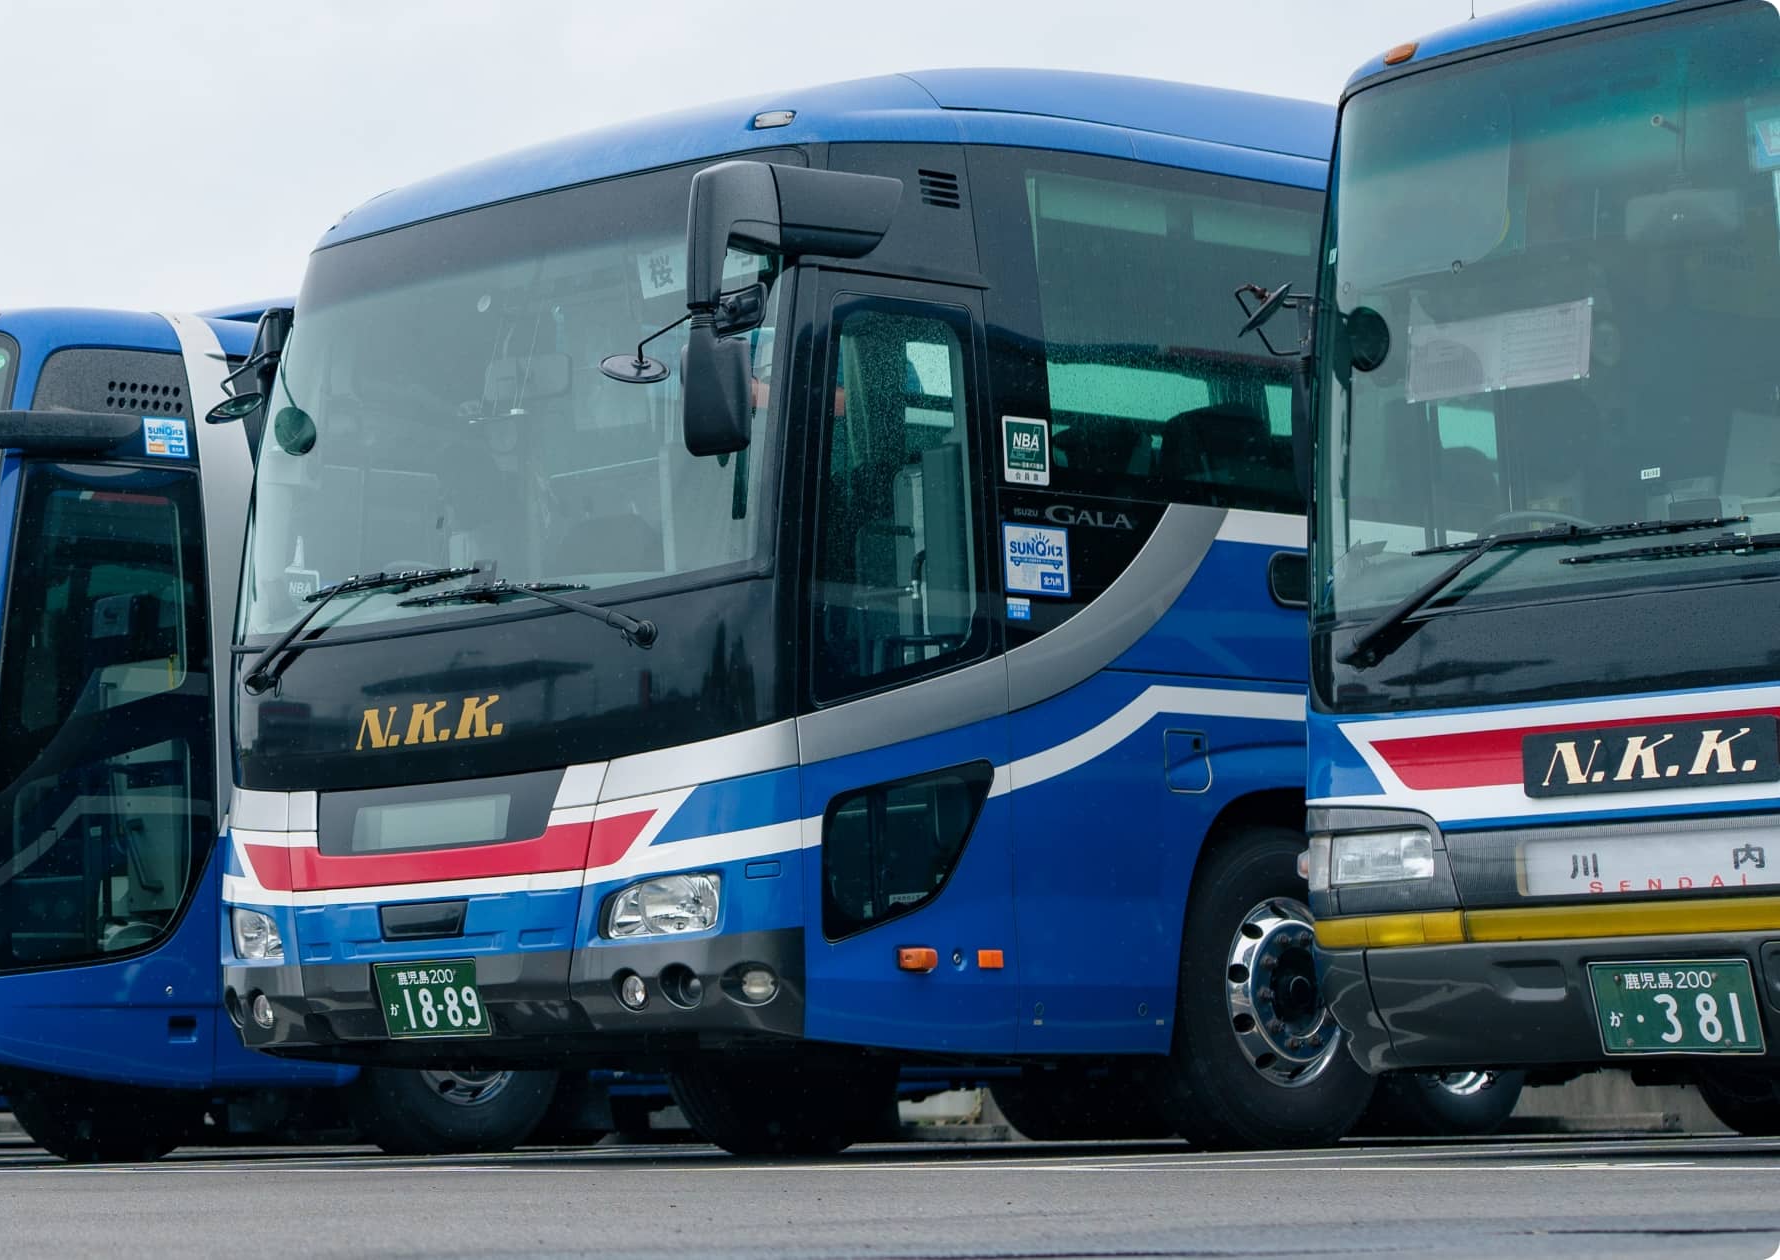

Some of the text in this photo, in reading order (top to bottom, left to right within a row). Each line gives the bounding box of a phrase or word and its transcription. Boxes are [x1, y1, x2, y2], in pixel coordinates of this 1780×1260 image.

[1012, 432, 1040, 449] NBA
[1014, 505, 1133, 530] ISUZU GALA
[289, 582, 312, 594] NBA
[355, 694, 504, 751] N.K.K.
[1541, 727, 1757, 786] N.K.K.
[397, 968, 454, 985] 鹿児島200
[1624, 971, 1712, 989] 鹿児島200
[403, 986, 482, 1030] 18-89
[1609, 1011, 1624, 1028] か
